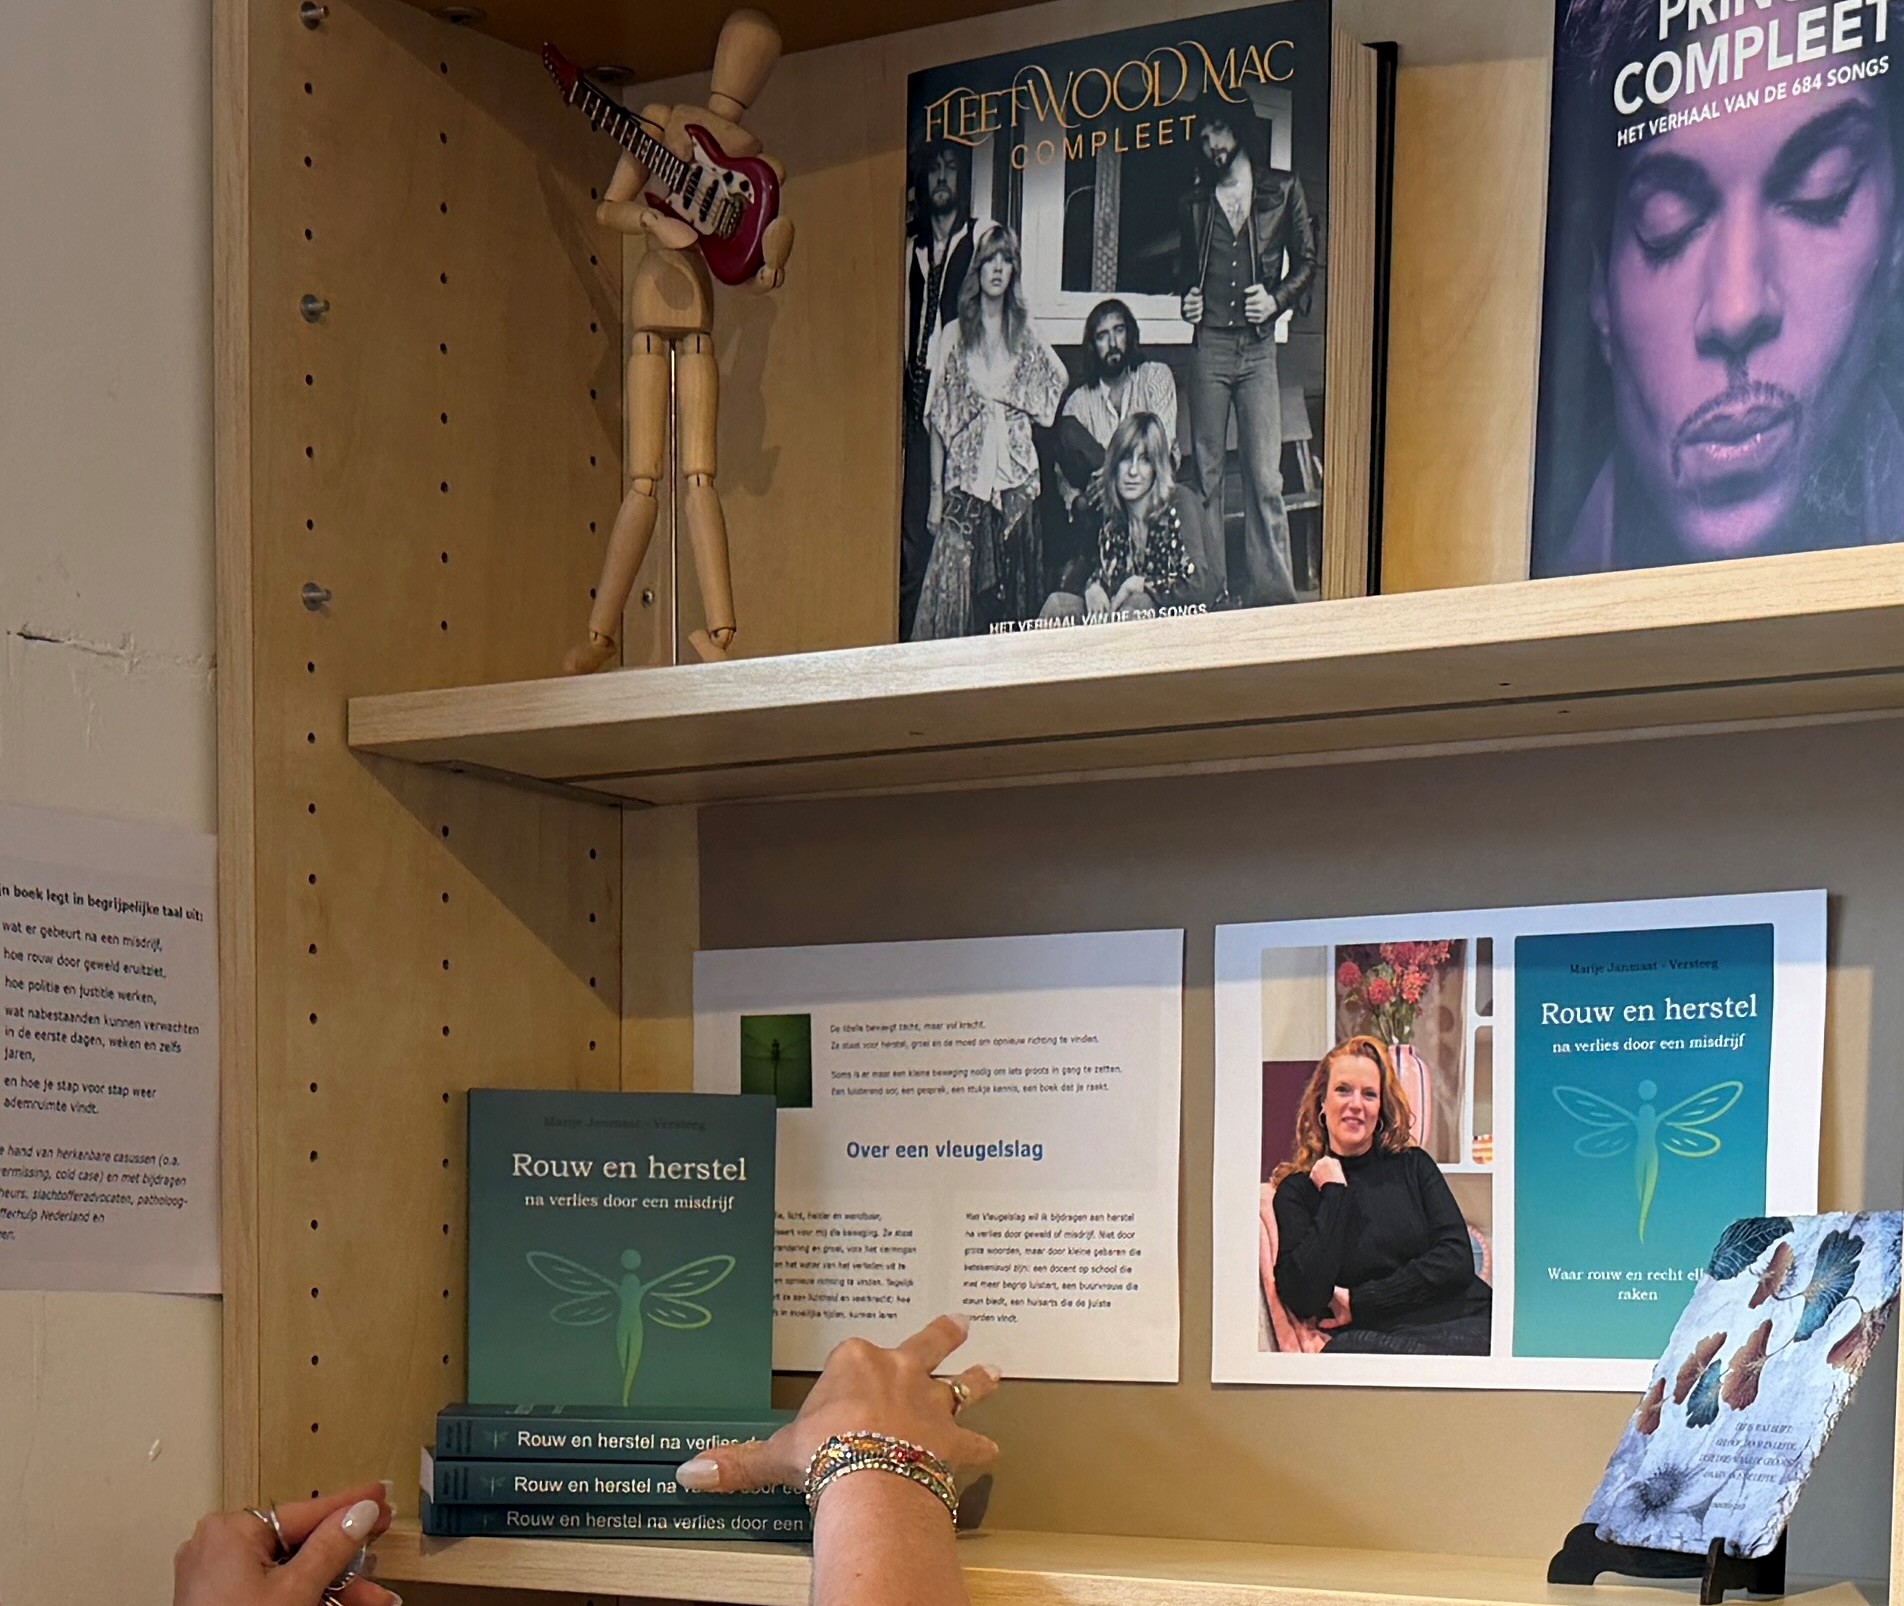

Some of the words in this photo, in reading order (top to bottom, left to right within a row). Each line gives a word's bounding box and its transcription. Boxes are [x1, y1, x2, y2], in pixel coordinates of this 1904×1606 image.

[1614, 0, 1888, 115] COMPLEET
[924, 47, 1188, 147] FLEETWOOD
[1178, 41, 1295, 103] MAC
[1617, 124, 1644, 147] HET
[1648, 102, 1720, 135] VERHAAL
[1724, 90, 1758, 114] VAN
[1765, 84, 1786, 104] DE
[1792, 74, 1822, 96] 684
[1826, 56, 1889, 88] SONGS
[1011, 114, 1196, 170] COMPLEET
[14, 885, 43, 900] boek
[47, 889, 69, 905] legt
[73, 892, 83, 905] in
[88, 894, 159, 917] begrijpelijke
[163, 903, 182, 917] taal
[186, 908, 203, 922] uit:
[2, 921, 22, 933] wat
[26, 924, 36, 934] er
[40, 924, 80, 941] gebeurt
[85, 932, 97, 943] na
[101, 934, 119, 944] een
[1541, 1002, 1614, 1024] Rouw
[1623, 1004, 1655, 1021] en
[1664, 993, 1758, 1020] herstel
[1552, 1044, 1571, 1053] na
[1575, 1038, 1619, 1052] verlies
[1623, 1038, 1656, 1050] door
[1660, 1040, 1684, 1050] een
[1689, 1033, 1746, 1050] misdrijf
[847, 1141, 890, 1159] Over
[895, 1145, 929, 1159] een
[935, 1140, 1044, 1162] vleugelslag
[512, 1153, 593, 1177] Rouw
[603, 1161, 637, 1179] en
[648, 1155, 746, 1181] herstel
[525, 1196, 544, 1207] na
[549, 1193, 598, 1208] verlies
[603, 1194, 638, 1208] door
[642, 1198, 669, 1209] een
[675, 1195, 735, 1213] misdrijf
[518, 1431, 566, 1447] Rouw
[572, 1435, 592, 1447] en
[598, 1432, 655, 1449] herstel
[660, 1436, 680, 1449] na
[507, 1511, 555, 1527] Rouw
[560, 1515, 580, 1528] en
[586, 1512, 642, 1529] herstel
[647, 1516, 667, 1529] na
[674, 1514, 725, 1530] verlies
[731, 1515, 767, 1530] door
[773, 1519, 803, 1532] een
